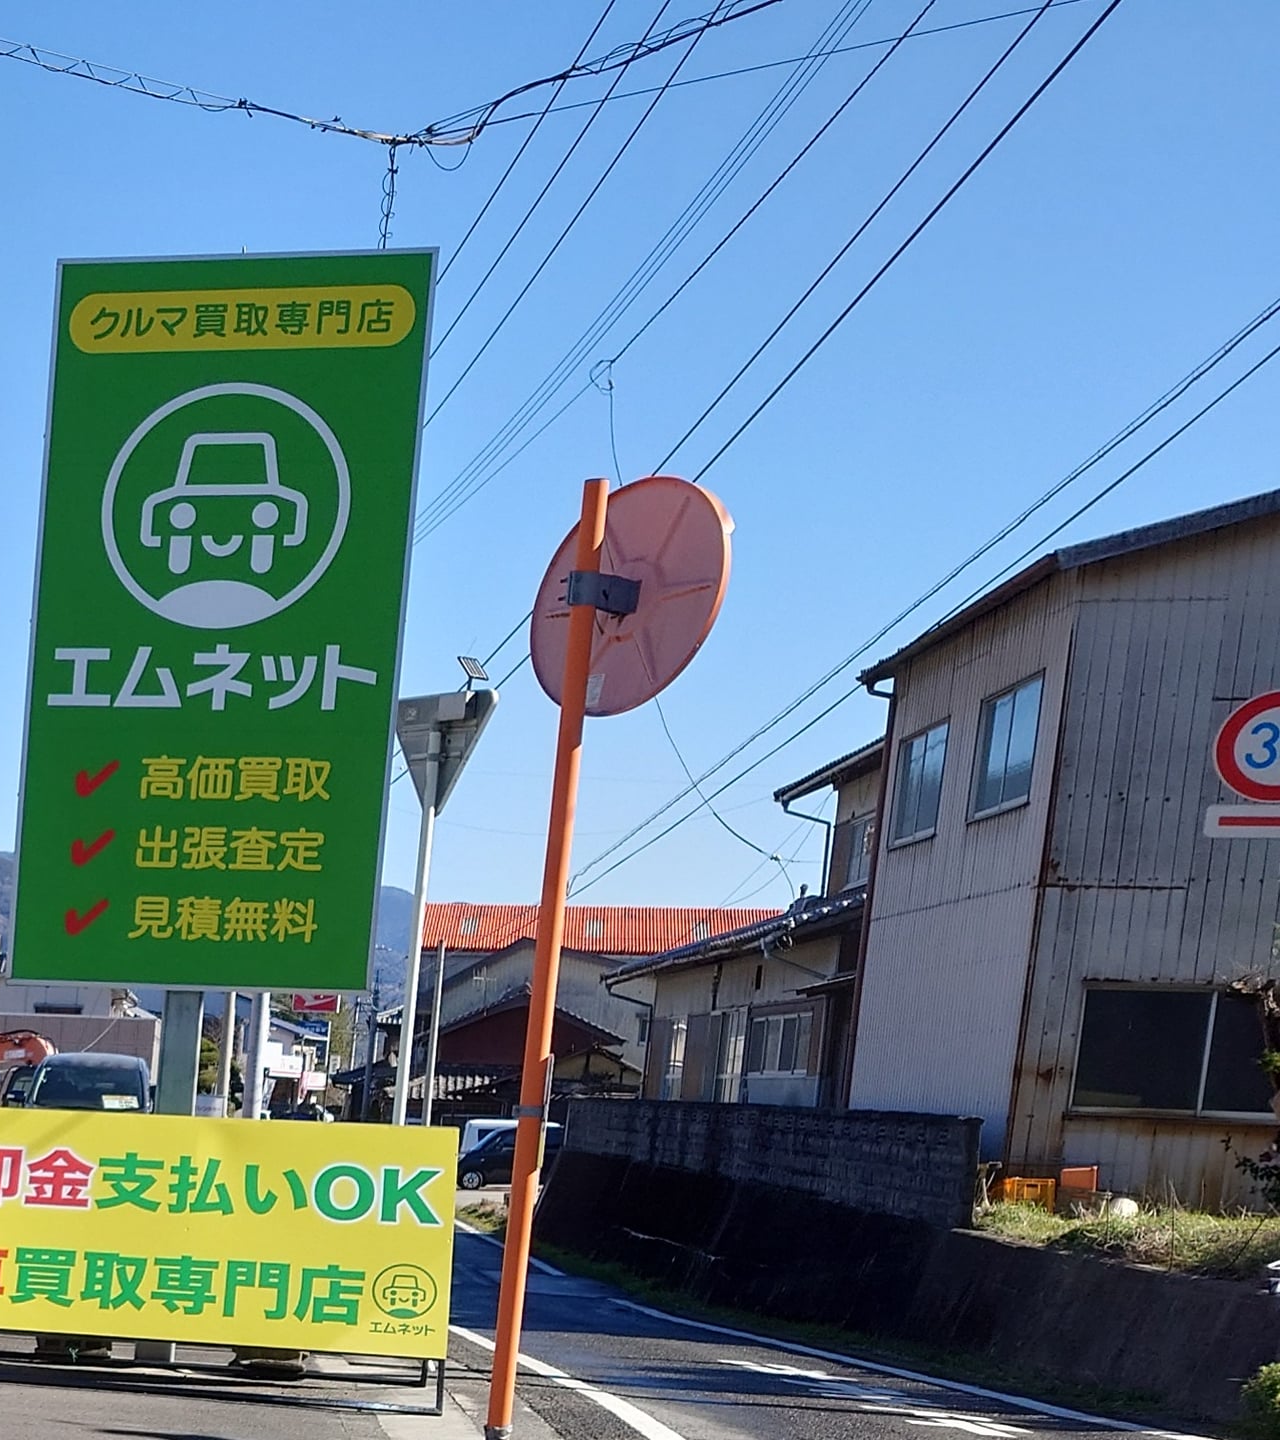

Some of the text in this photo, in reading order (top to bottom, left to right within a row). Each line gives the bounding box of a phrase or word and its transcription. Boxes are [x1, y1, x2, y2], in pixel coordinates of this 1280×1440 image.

[90, 299, 395, 341] クルマ買取専門店
[46, 643, 378, 712] エムネット
[140, 755, 332, 802] 高価買取
[135, 825, 325, 872] 出張査定
[127, 895, 318, 943] 見積無料
[369, 1321, 436, 1336] エムネット
